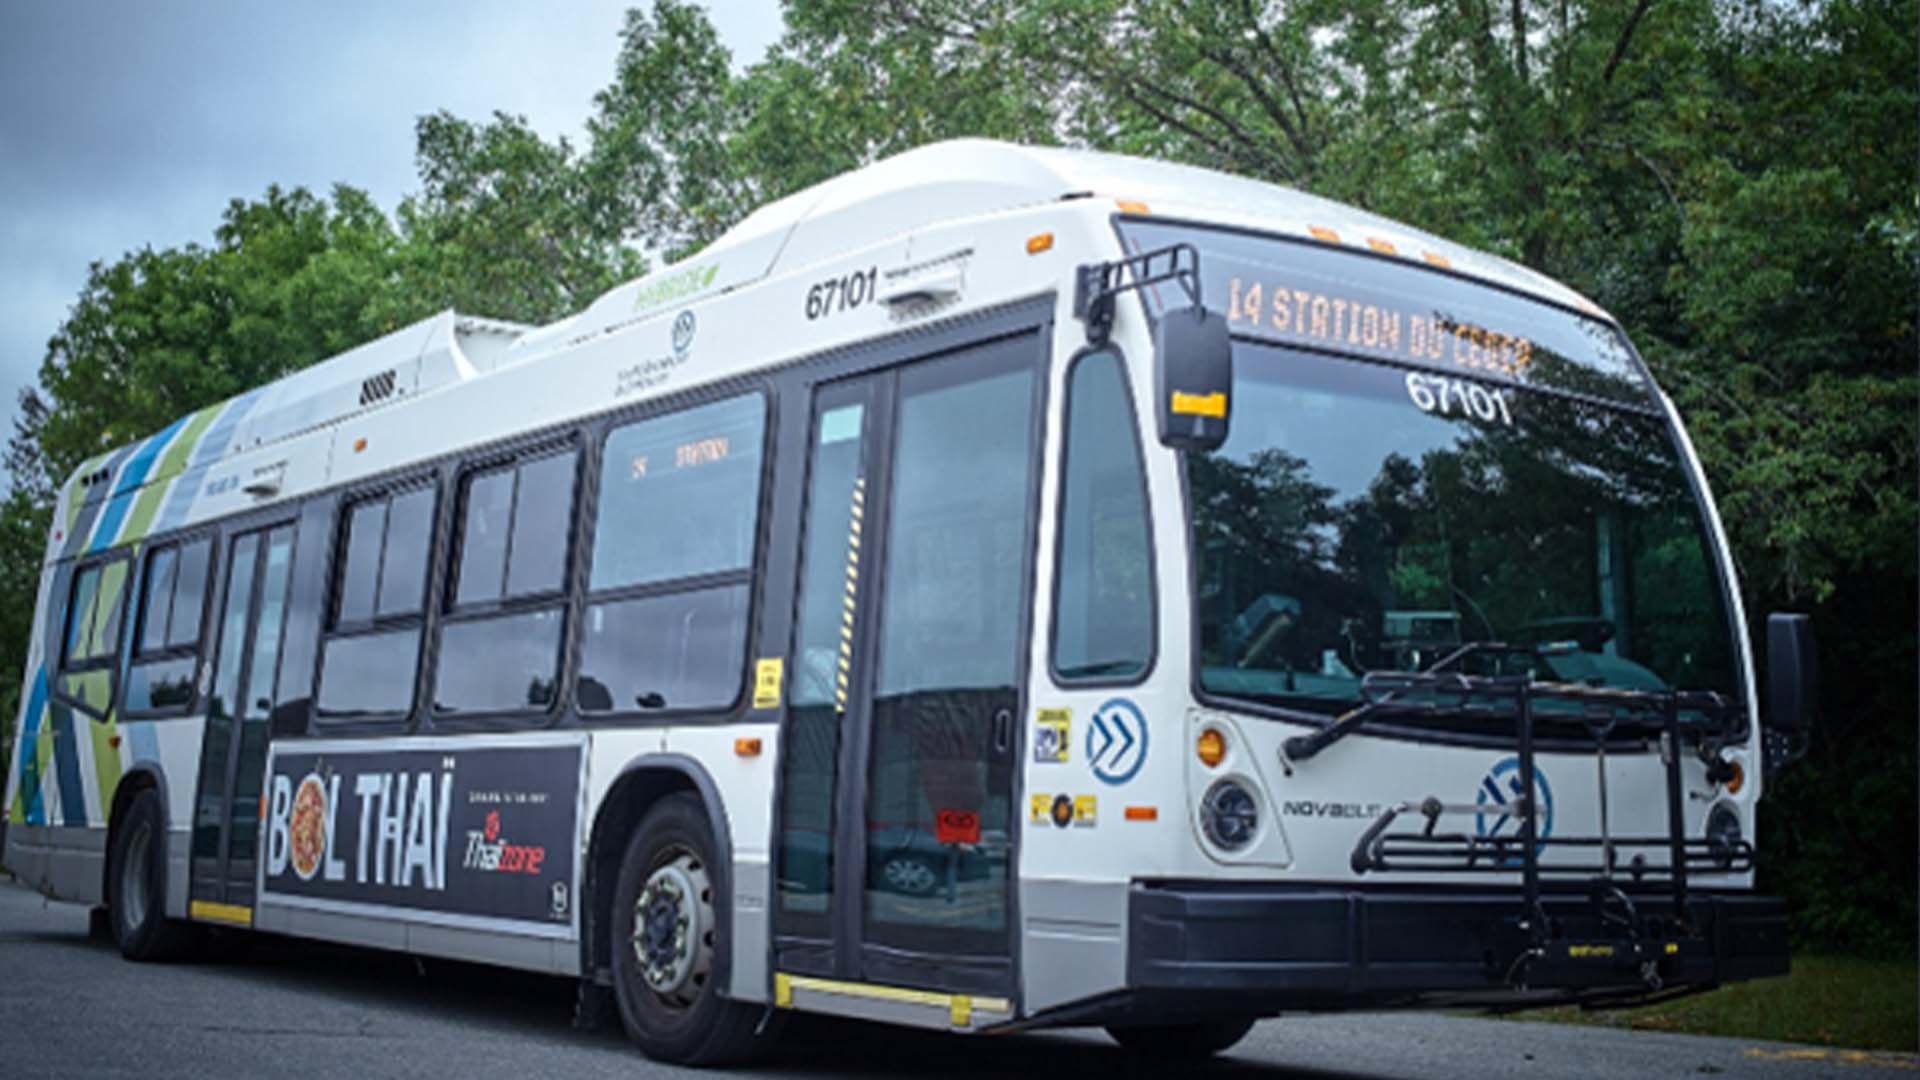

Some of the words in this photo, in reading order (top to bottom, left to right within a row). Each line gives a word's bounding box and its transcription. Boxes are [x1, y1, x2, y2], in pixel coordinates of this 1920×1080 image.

[805, 266, 877, 321] 67101
[1228, 277, 1263, 326] 14
[1272, 287, 1400, 350] STATION
[1405, 371, 1512, 426] 67101
[267, 772, 346, 881] BOL
[355, 756, 456, 891] THAÏ
